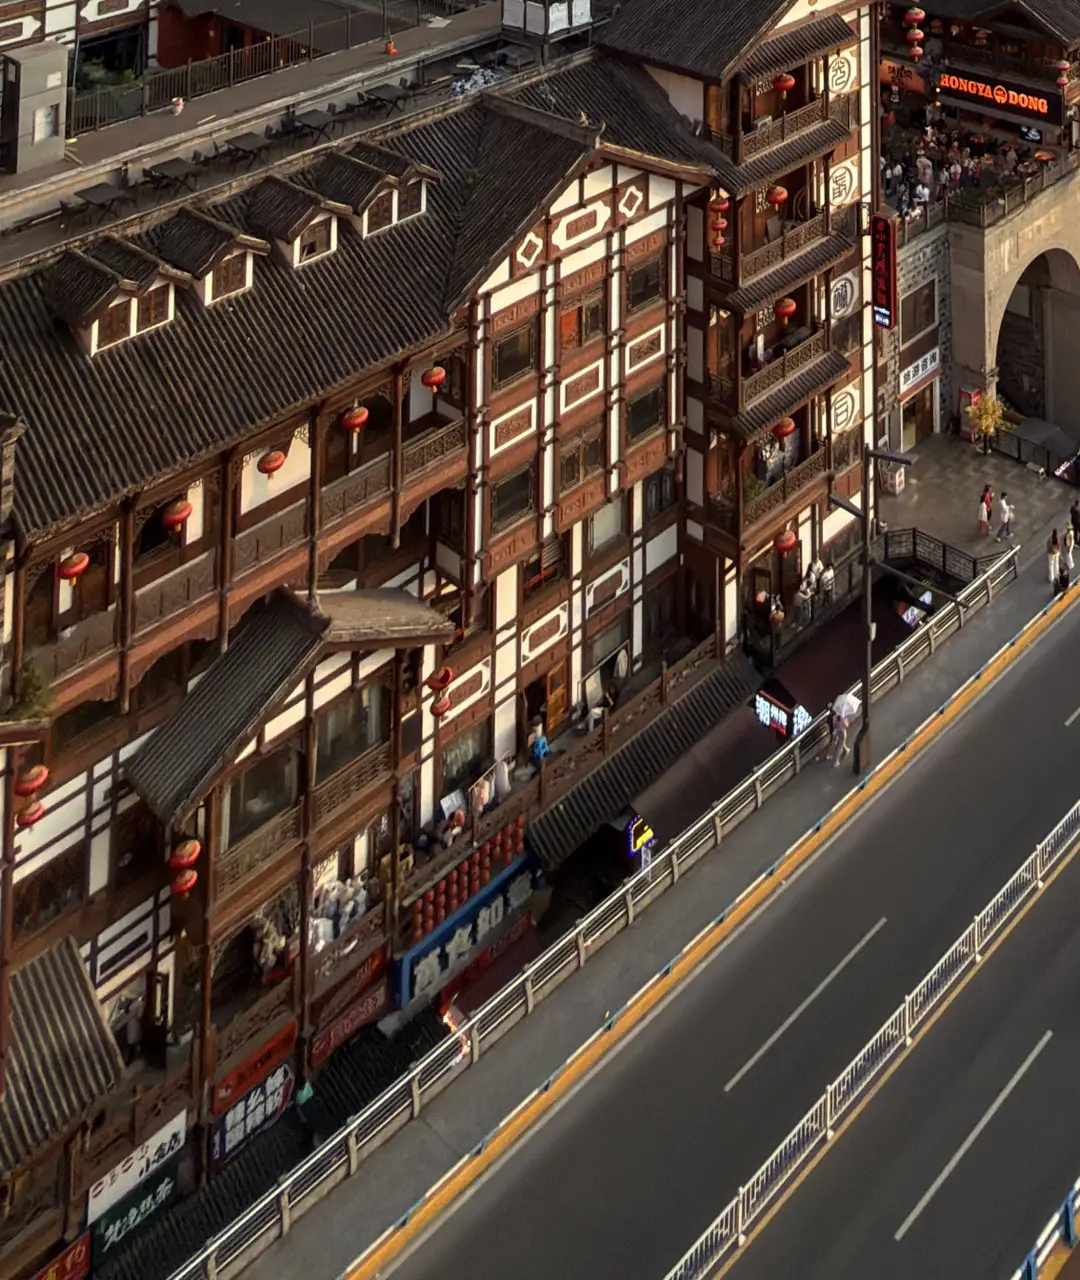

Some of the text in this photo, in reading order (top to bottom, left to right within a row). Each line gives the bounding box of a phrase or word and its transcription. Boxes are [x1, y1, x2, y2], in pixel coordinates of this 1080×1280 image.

[940, 73, 993, 100] HONGYA
[1008, 91, 1048, 114] DONG
[903, 351, 937, 385] 旅游咨询
